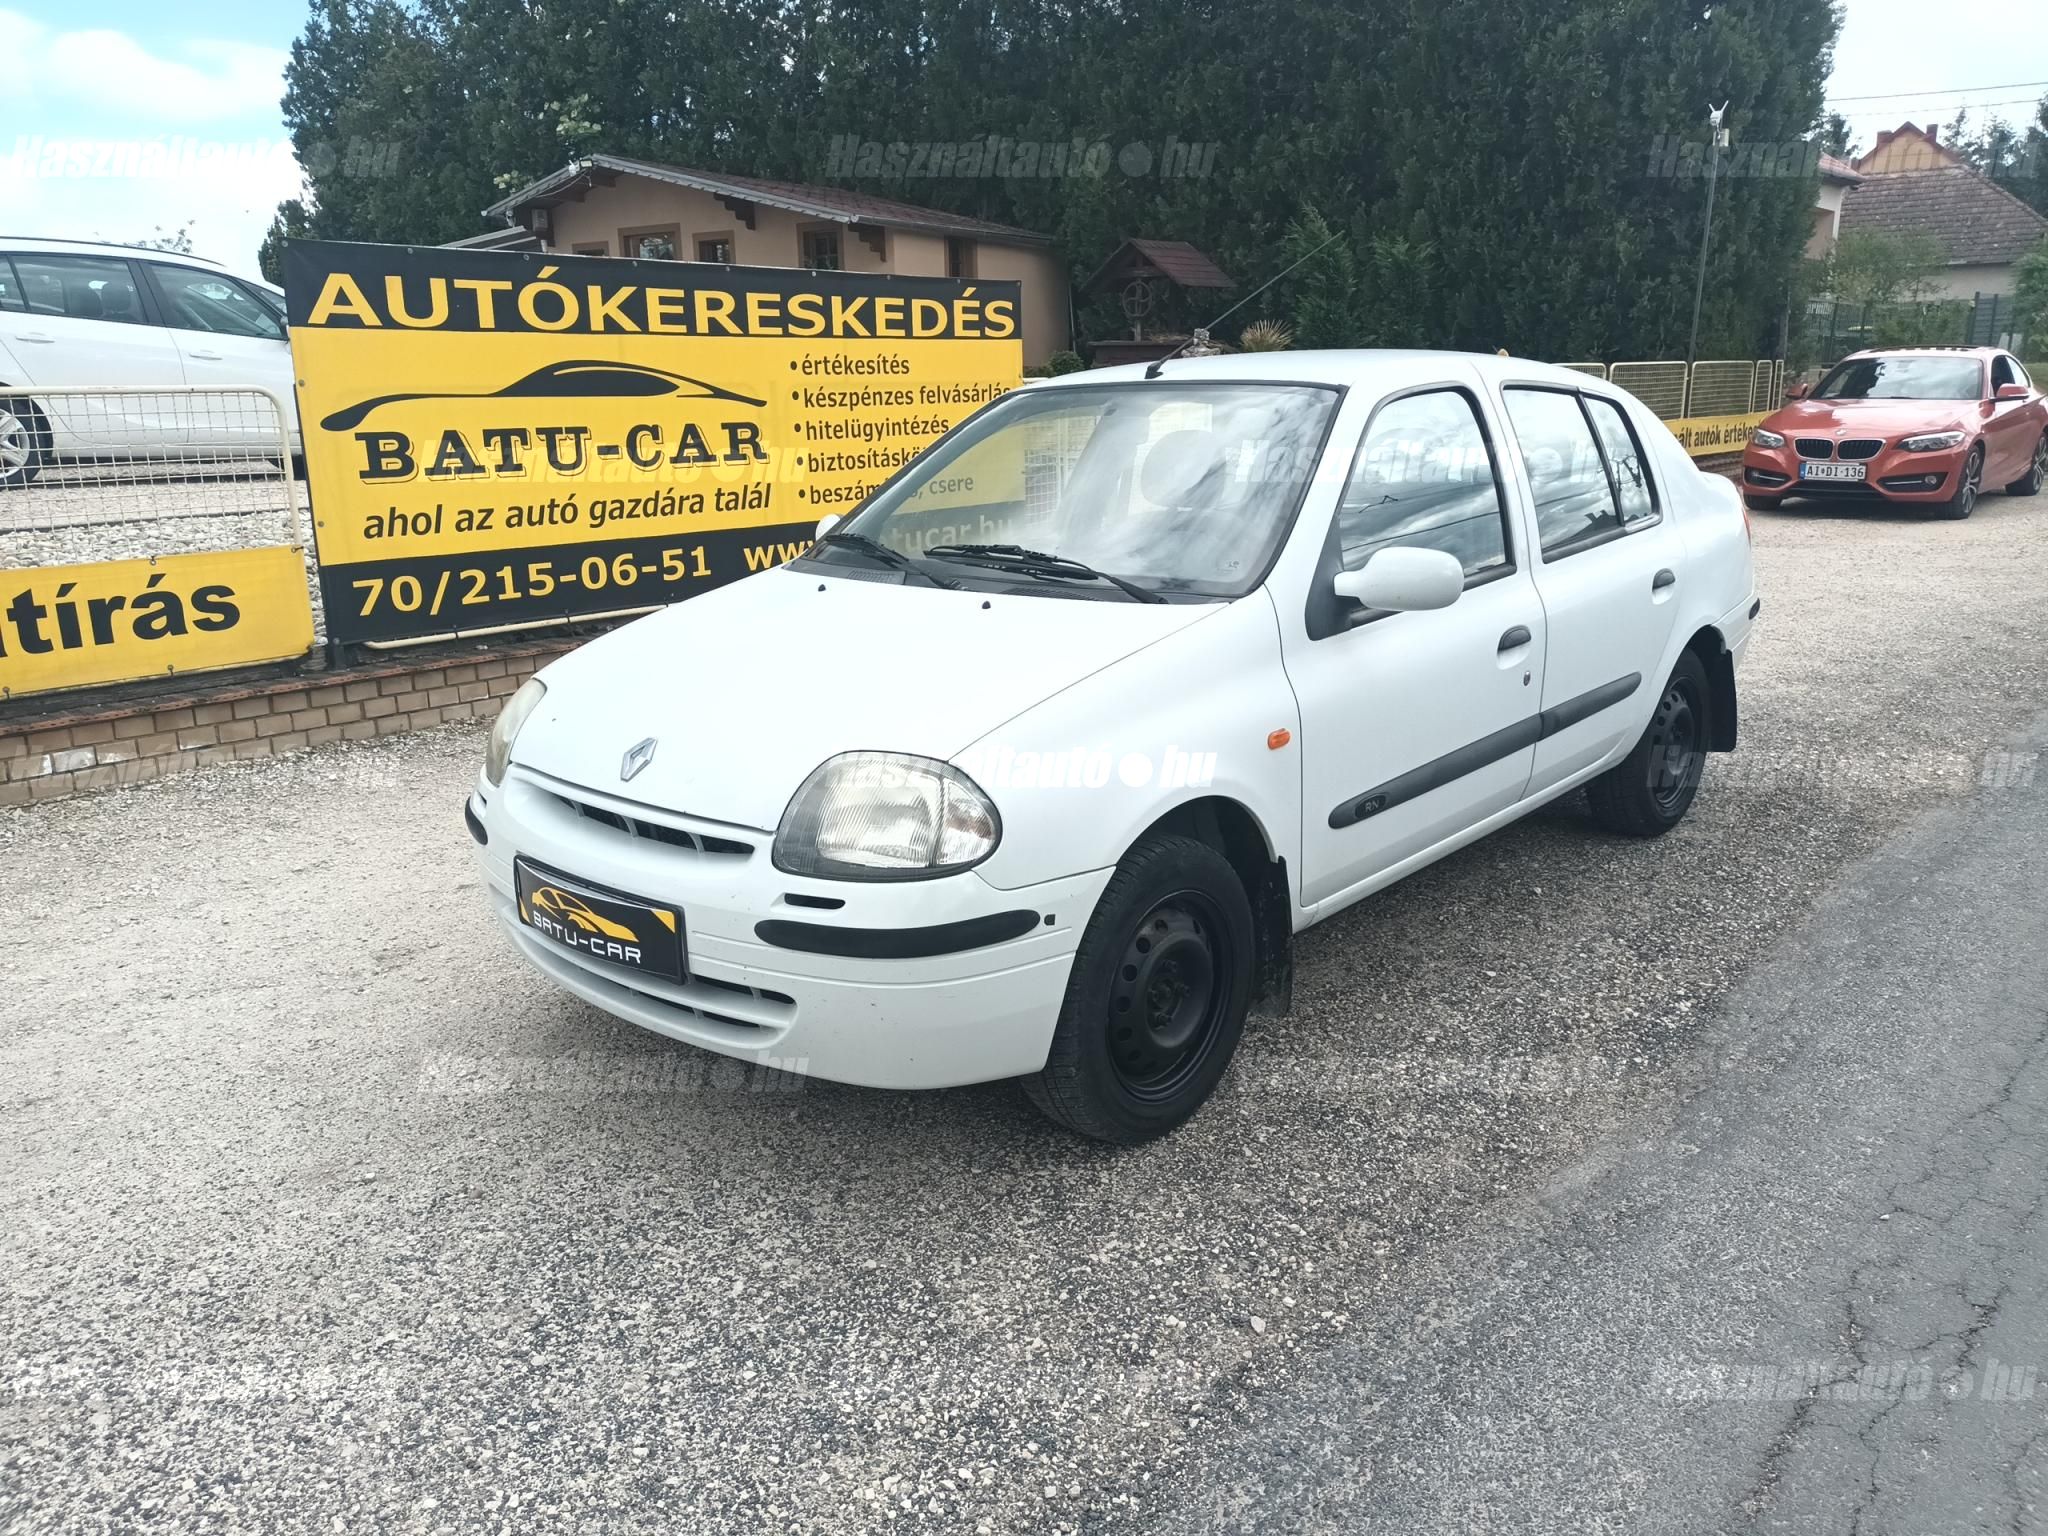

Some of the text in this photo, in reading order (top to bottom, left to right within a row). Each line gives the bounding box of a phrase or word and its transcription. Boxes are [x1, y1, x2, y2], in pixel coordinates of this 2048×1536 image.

[307, 265, 1015, 338] AUTÓKERESKEDÉS
[801, 353, 910, 376] értékesítés
[803, 387, 914, 411] készpénzes
[355, 421, 769, 484] BATU-CAR
[805, 414, 950, 442] hitelügyintézés
[1694, 425, 1721, 446] autók
[363, 482, 772, 540] ahol az autó gazdára talál
[929, 476, 975, 494] csere
[353, 540, 814, 617] 70/215-06-51 ww
[0, 573, 241, 658] tírás
[533, 911, 642, 964] BATU-CAR
